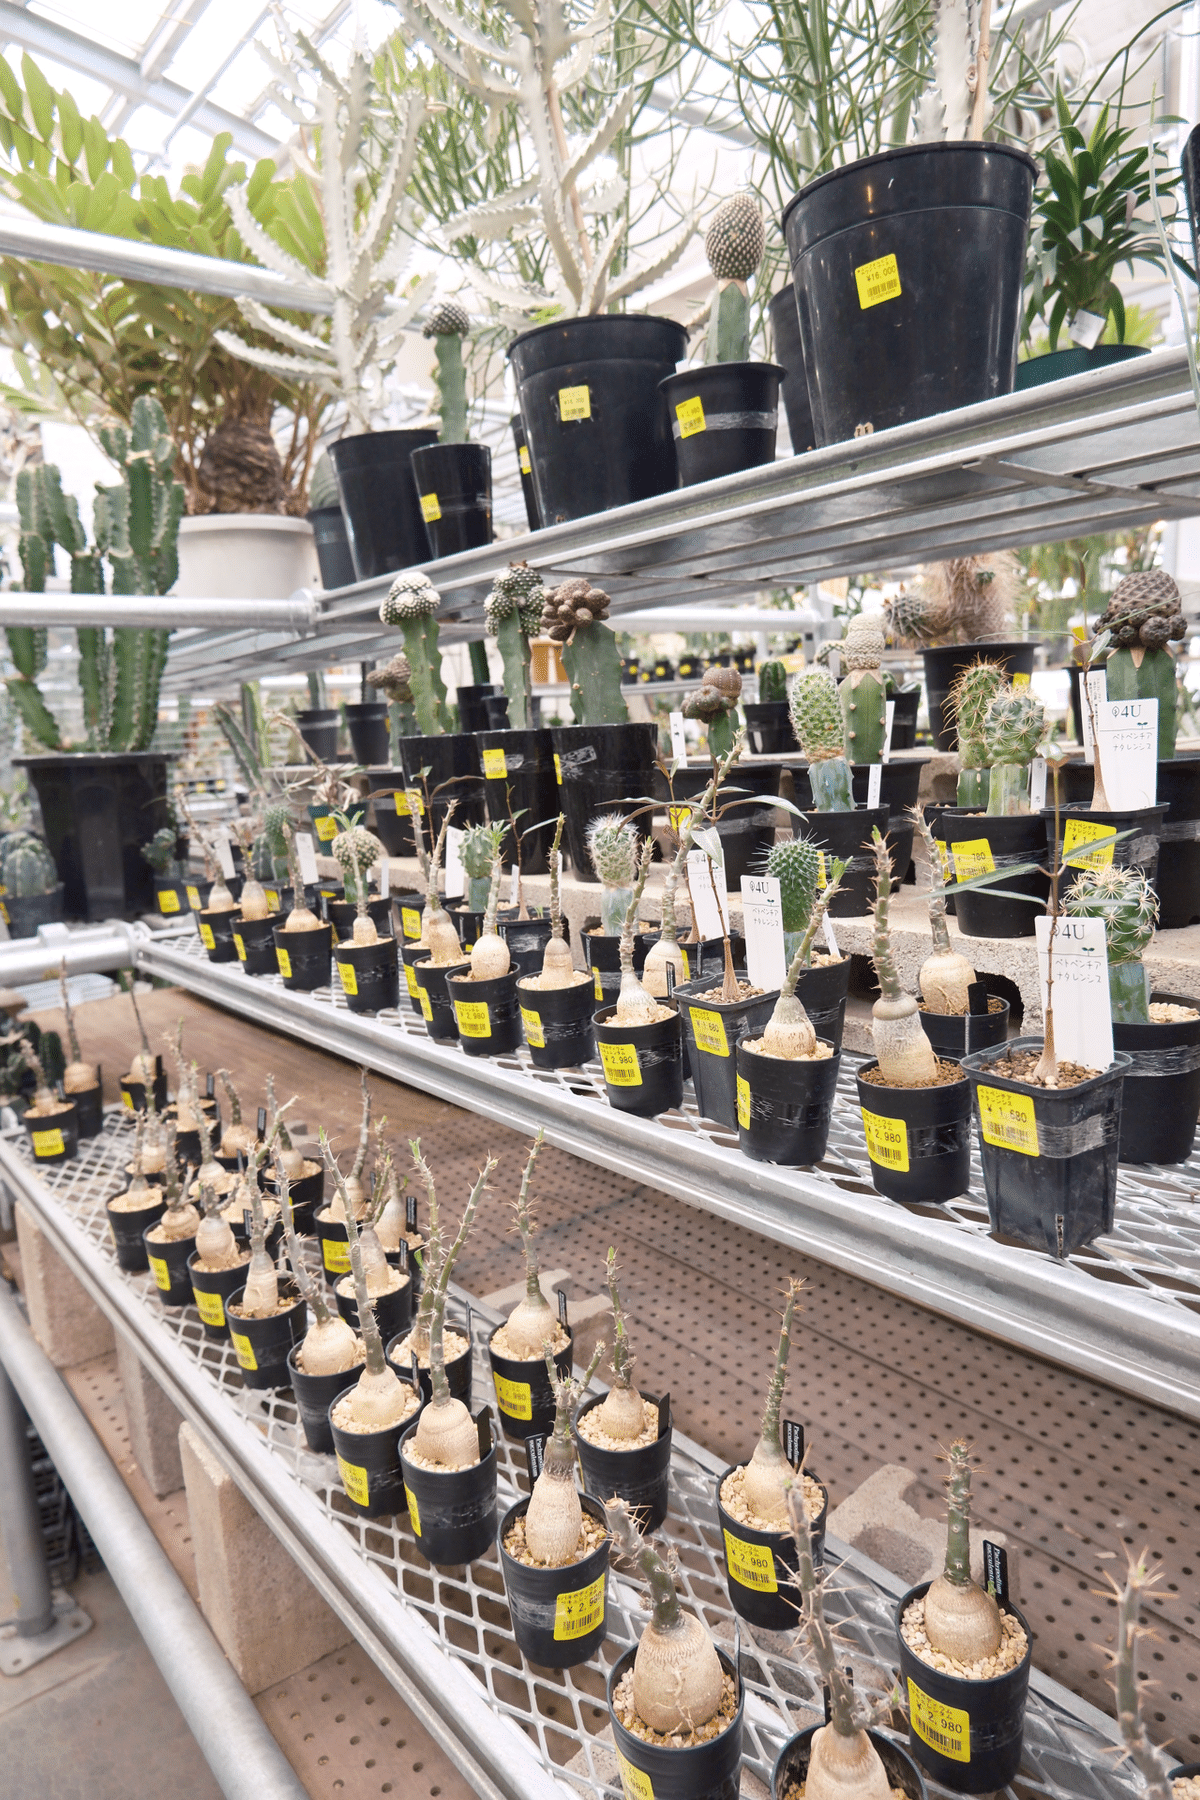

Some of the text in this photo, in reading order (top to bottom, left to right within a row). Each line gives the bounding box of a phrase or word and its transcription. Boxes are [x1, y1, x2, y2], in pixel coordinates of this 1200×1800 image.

[1112, 731, 1153, 740] ペトペンチア
[1055, 958, 1102, 969] ペトペンチア
[1056, 972, 1102, 983] ナタレンシス
[611, 1055, 634, 1065] 2,980
[874, 1128, 902, 1144] 2,980
[741, 1553, 768, 1569] 2,980
[927, 1710, 963, 1734] 2,980
